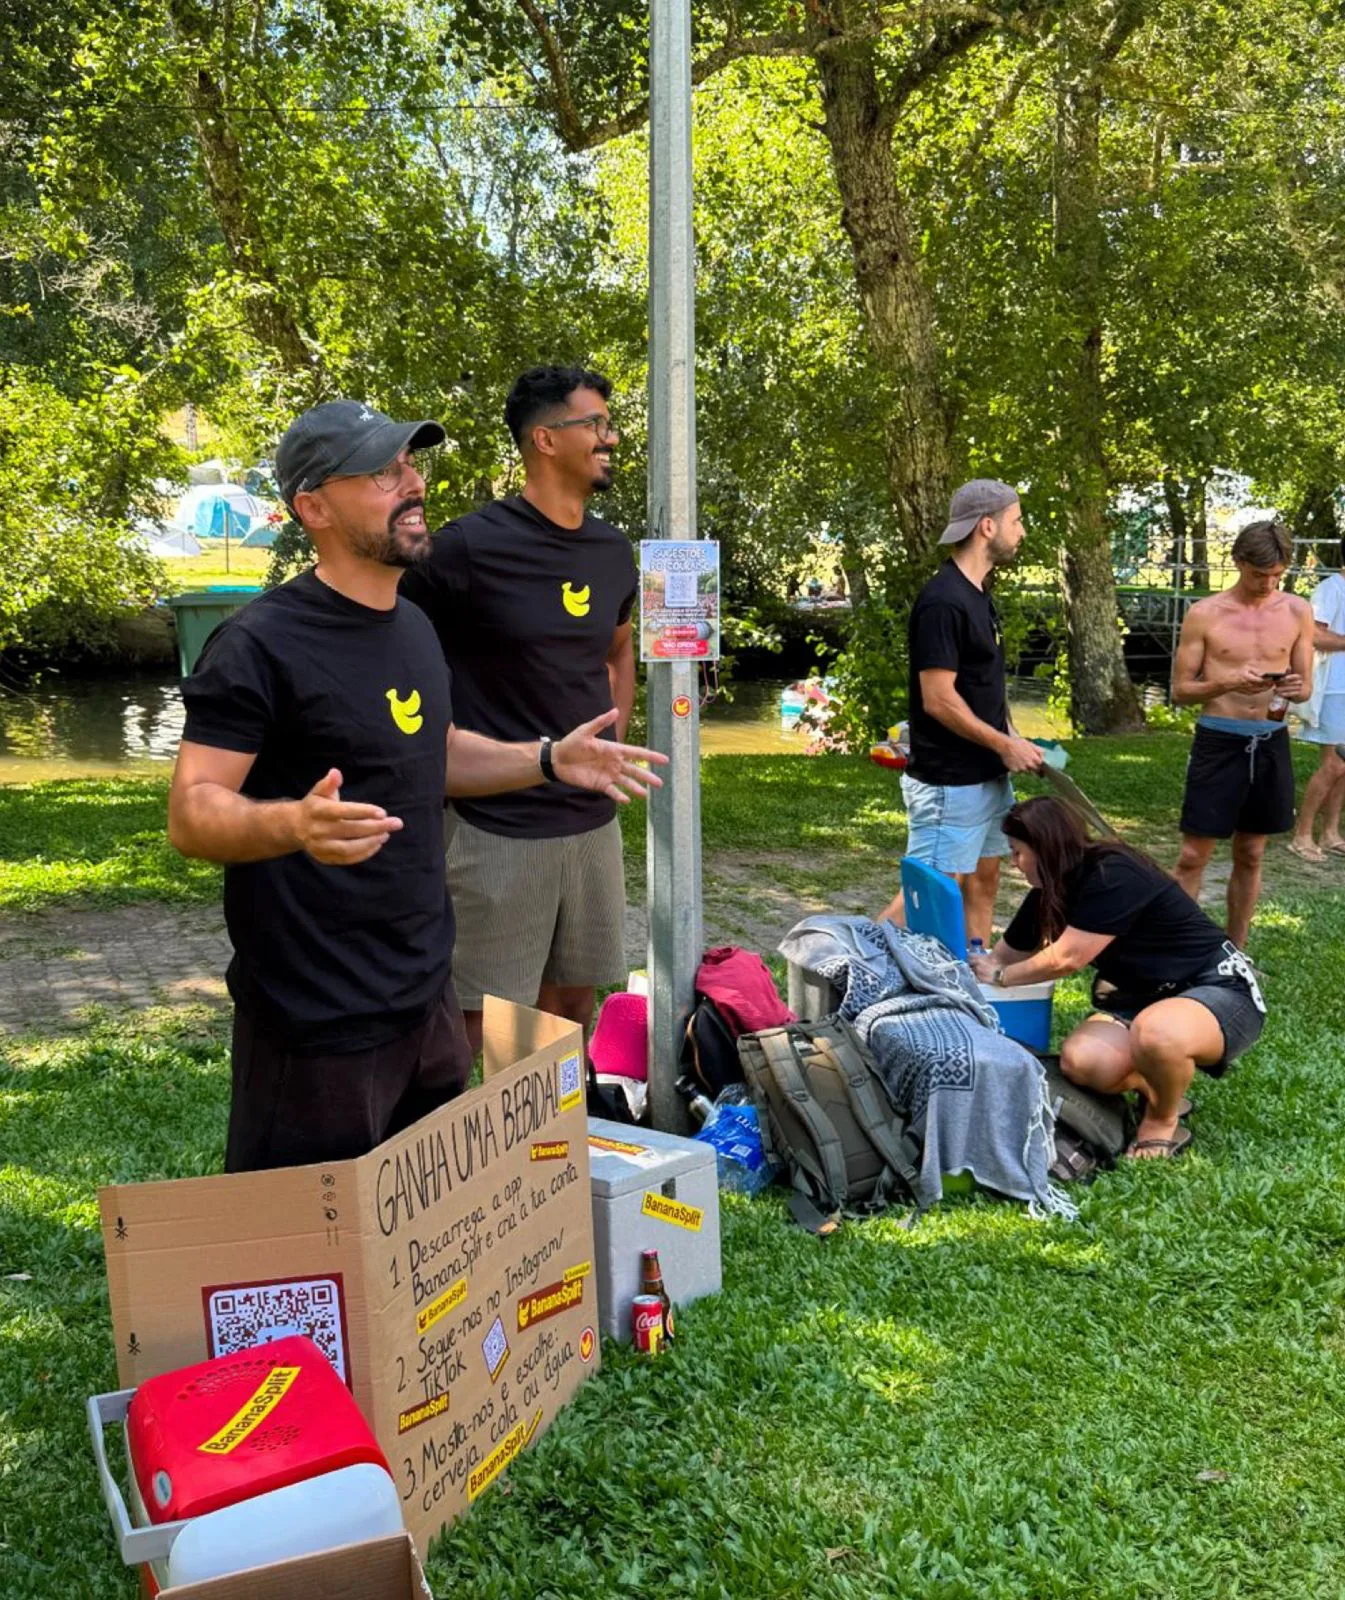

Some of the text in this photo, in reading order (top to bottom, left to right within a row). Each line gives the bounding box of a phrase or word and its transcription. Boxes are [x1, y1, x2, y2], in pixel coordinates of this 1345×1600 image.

[376, 1061, 559, 1236] GANHA UMA BEBIDA!
[389, 1175, 522, 1289] 1. Descarrega a app
[412, 1232, 483, 1306] BananaSplit
[485, 1231, 494, 1250] e
[519, 1202, 529, 1220] a
[530, 1187, 547, 1211] tua
[550, 1161, 579, 1195] conta
[644, 1195, 702, 1227] BananaSplit
[396, 1355, 411, 1392] 2.
[416, 1305, 483, 1373] Segue-nos
[486, 1289, 501, 1314] no
[504, 1226, 564, 1298] Instagram/
[427, 1281, 467, 1320] BananaSplit
[530, 1279, 582, 1319] BananaSplit
[420, 1349, 468, 1401] TikTok
[501, 1381, 510, 1401] e
[516, 1327, 559, 1385] escolhe:
[203, 1370, 293, 1450] BananaSplit
[399, 1393, 448, 1431] BananaSplit
[490, 1401, 519, 1443] cola
[523, 1376, 540, 1407] ou
[470, 1424, 526, 1494] BananaSplit
